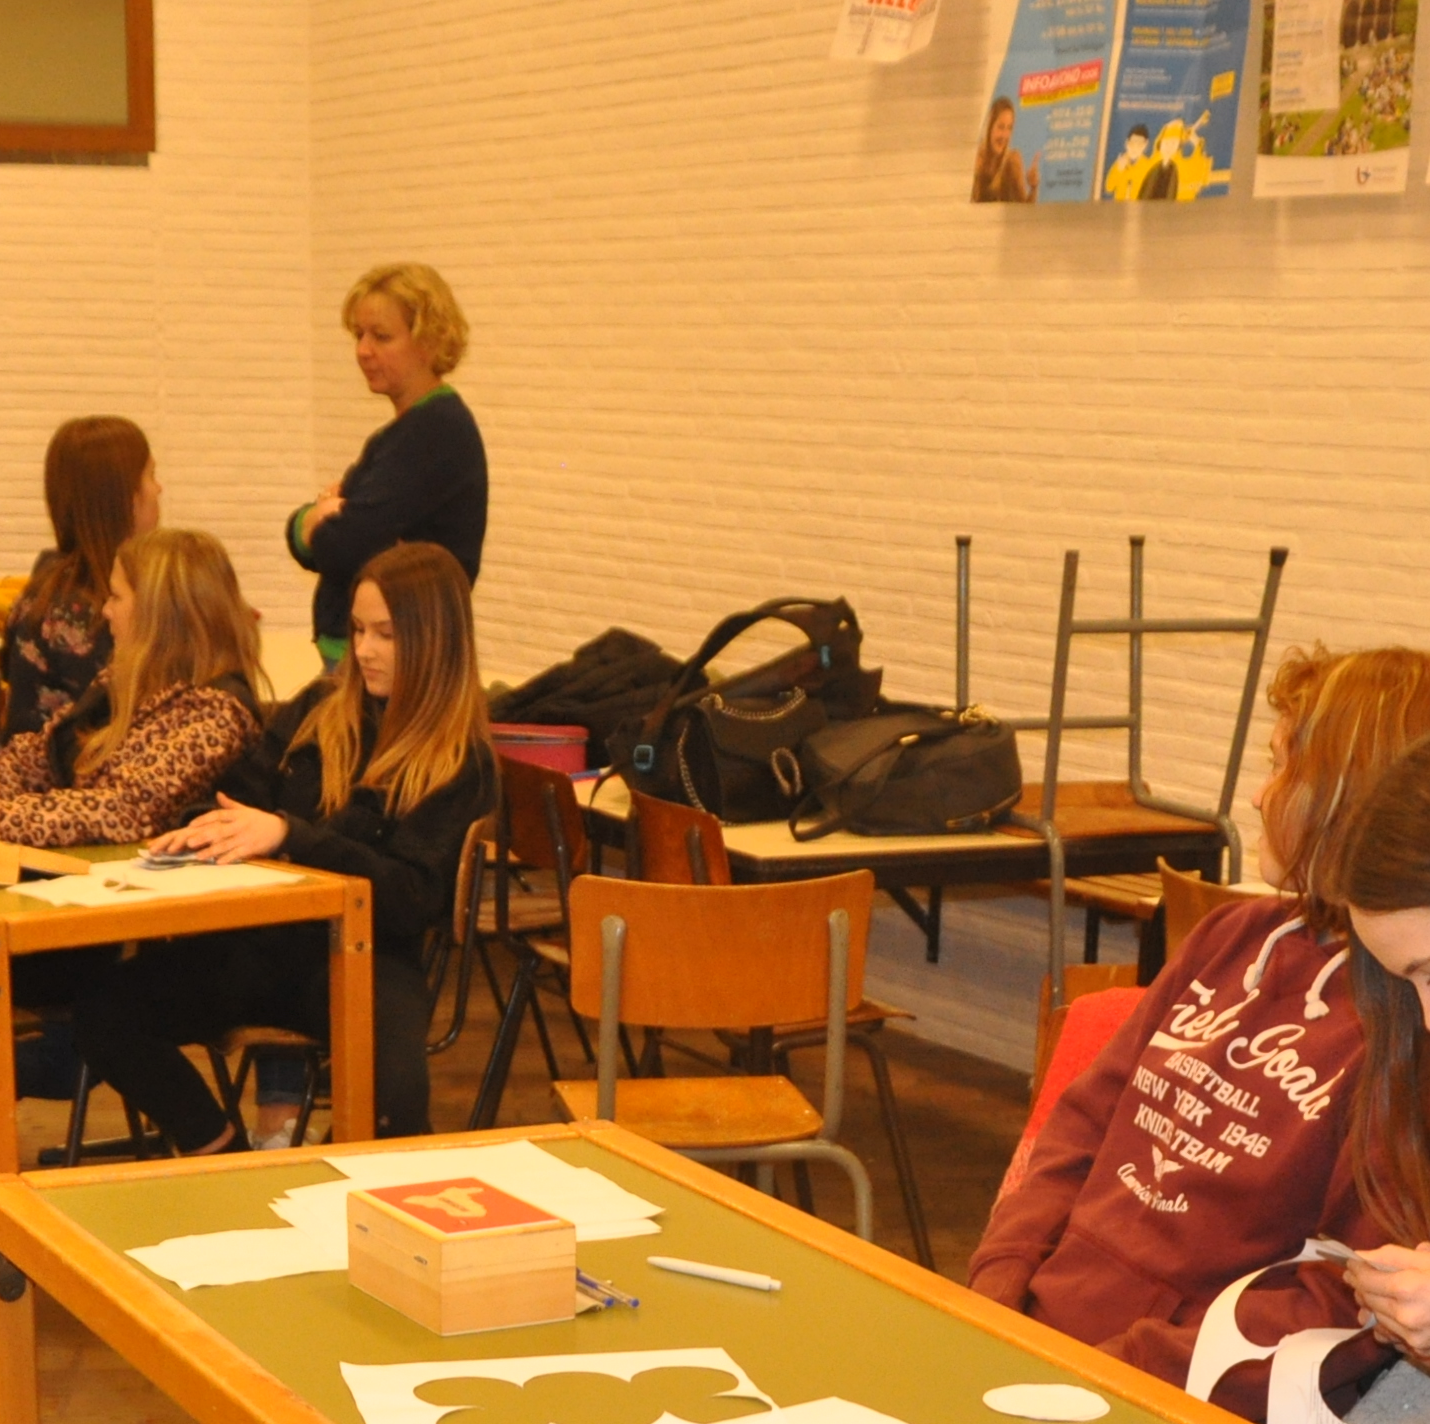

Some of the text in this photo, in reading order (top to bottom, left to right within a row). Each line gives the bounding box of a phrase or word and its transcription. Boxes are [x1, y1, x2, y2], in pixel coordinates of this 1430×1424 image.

[1132, 1065, 1272, 1158] NEW YRK 1946
[1226, 1023, 1345, 1121] Goals
[1169, 1128, 1234, 1174] TEAM
